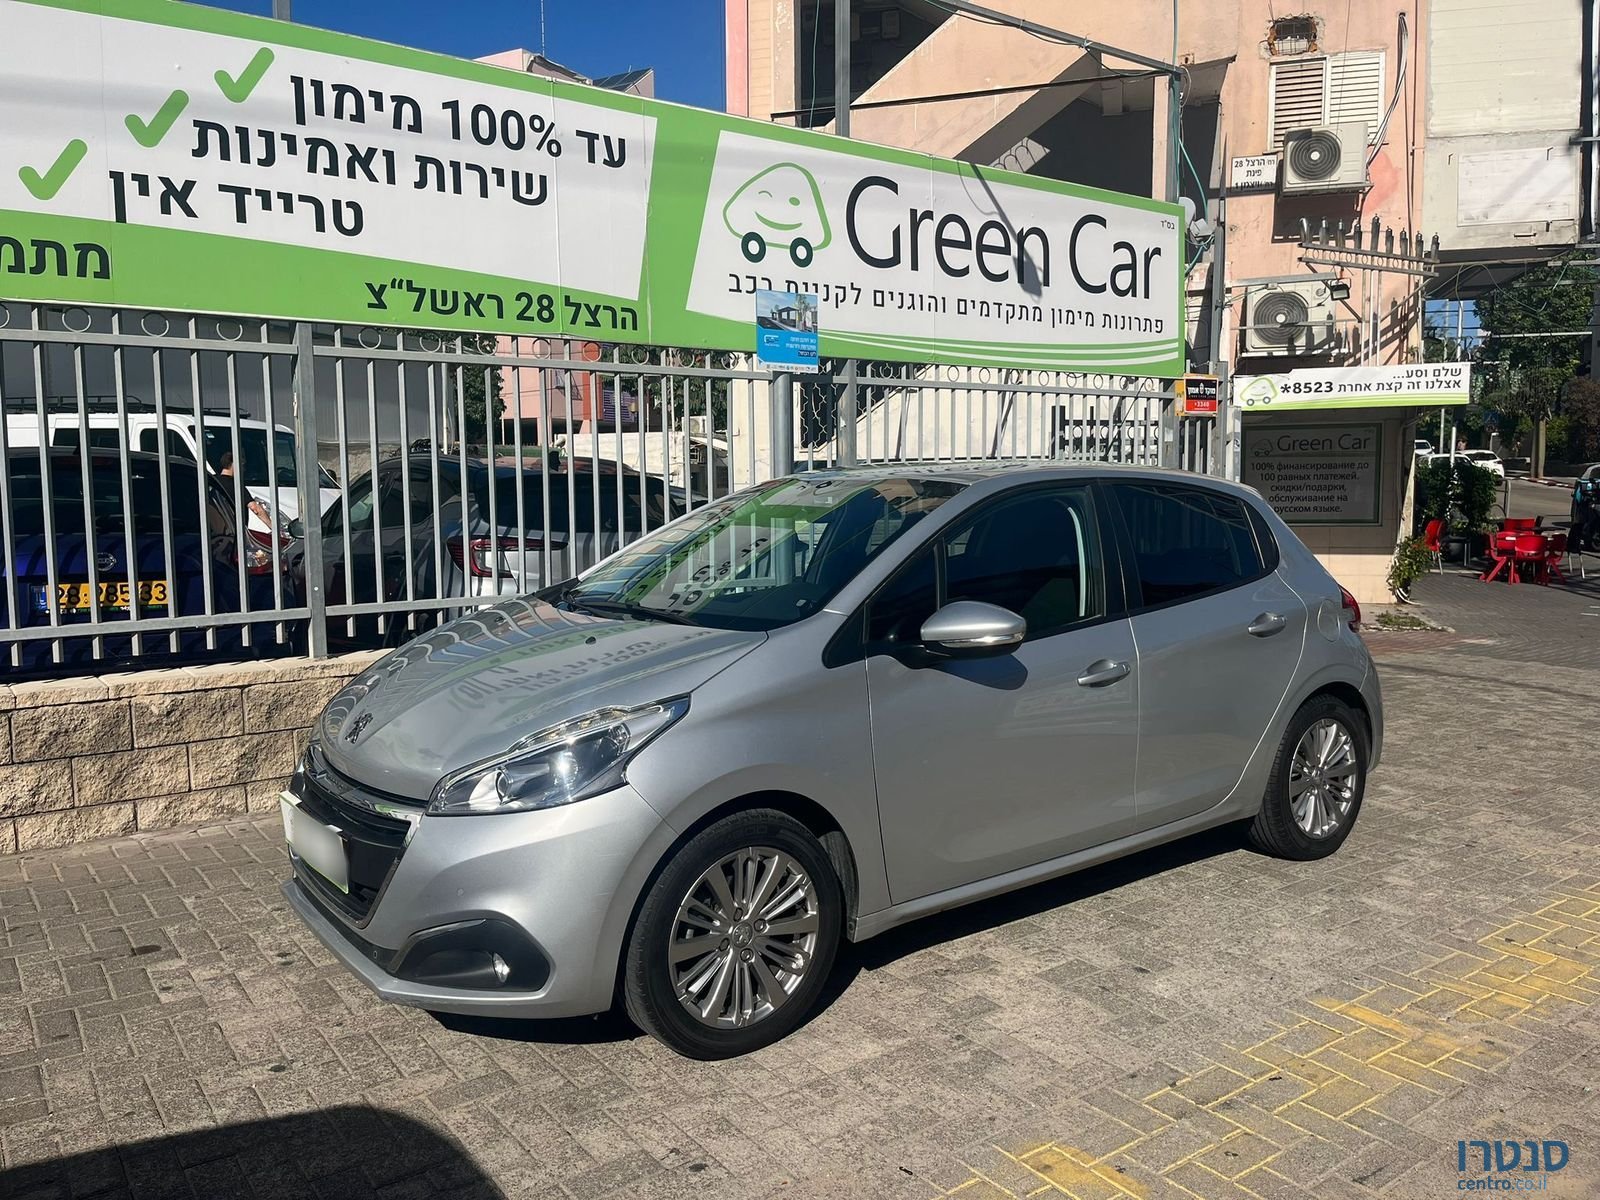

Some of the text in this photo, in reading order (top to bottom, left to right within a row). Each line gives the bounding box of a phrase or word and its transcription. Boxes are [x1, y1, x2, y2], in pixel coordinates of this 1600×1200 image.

[289, 75, 625, 167] עד 100% מימון
[192, 119, 548, 205] שירות ואמינות
[1234, 160, 1244, 168] 28
[109, 171, 363, 236] טרייד אין
[846, 175, 1161, 299] Green Car
[516, 292, 555, 323] 28
[874, 290, 945, 313] והוגנים
[957, 298, 1042, 324] מתקדמים
[564, 295, 638, 331] הרצל
[1052, 308, 1094, 328] מימון
[1102, 314, 1162, 333] פתרונות
[1433, 366, 1462, 378] שלם
[1338, 382, 1371, 393] אחרת
[1375, 381, 1403, 394] קצת
[1407, 380, 1421, 390] זה
[1425, 377, 1462, 389] אצלנו
[1277, 433, 1371, 452] Green Car
[1251, 461, 1370, 472] 100% финансирование до
[1260, 472, 1275, 481] 100
[1277, 473, 1311, 483] равных
[1268, 494, 1348, 504] обслуживание на
